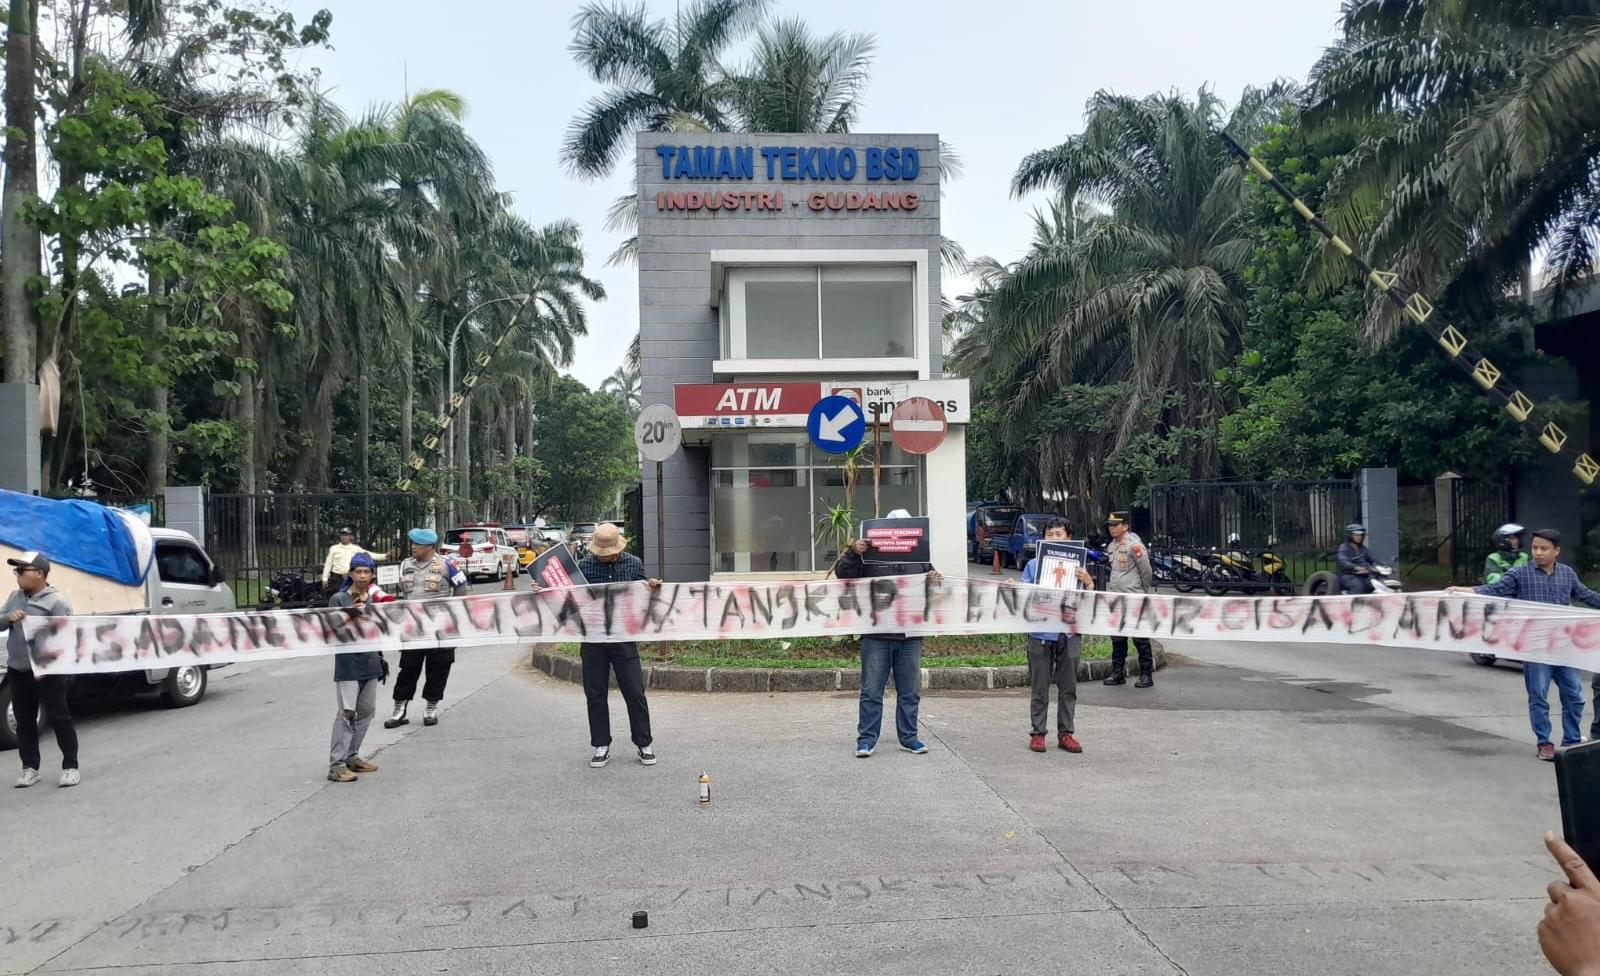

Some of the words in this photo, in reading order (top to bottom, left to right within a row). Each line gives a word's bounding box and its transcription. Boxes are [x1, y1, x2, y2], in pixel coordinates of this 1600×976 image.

[656, 144, 754, 180] TAMAN
[761, 146, 857, 181] TEKNO
[866, 147, 921, 182] BSD
[656, 191, 784, 212] INDUSTRI
[807, 191, 919, 212] GUDANG
[715, 387, 782, 411] ATM
[866, 387, 892, 396] bank
[642, 421, 665, 444] 20
